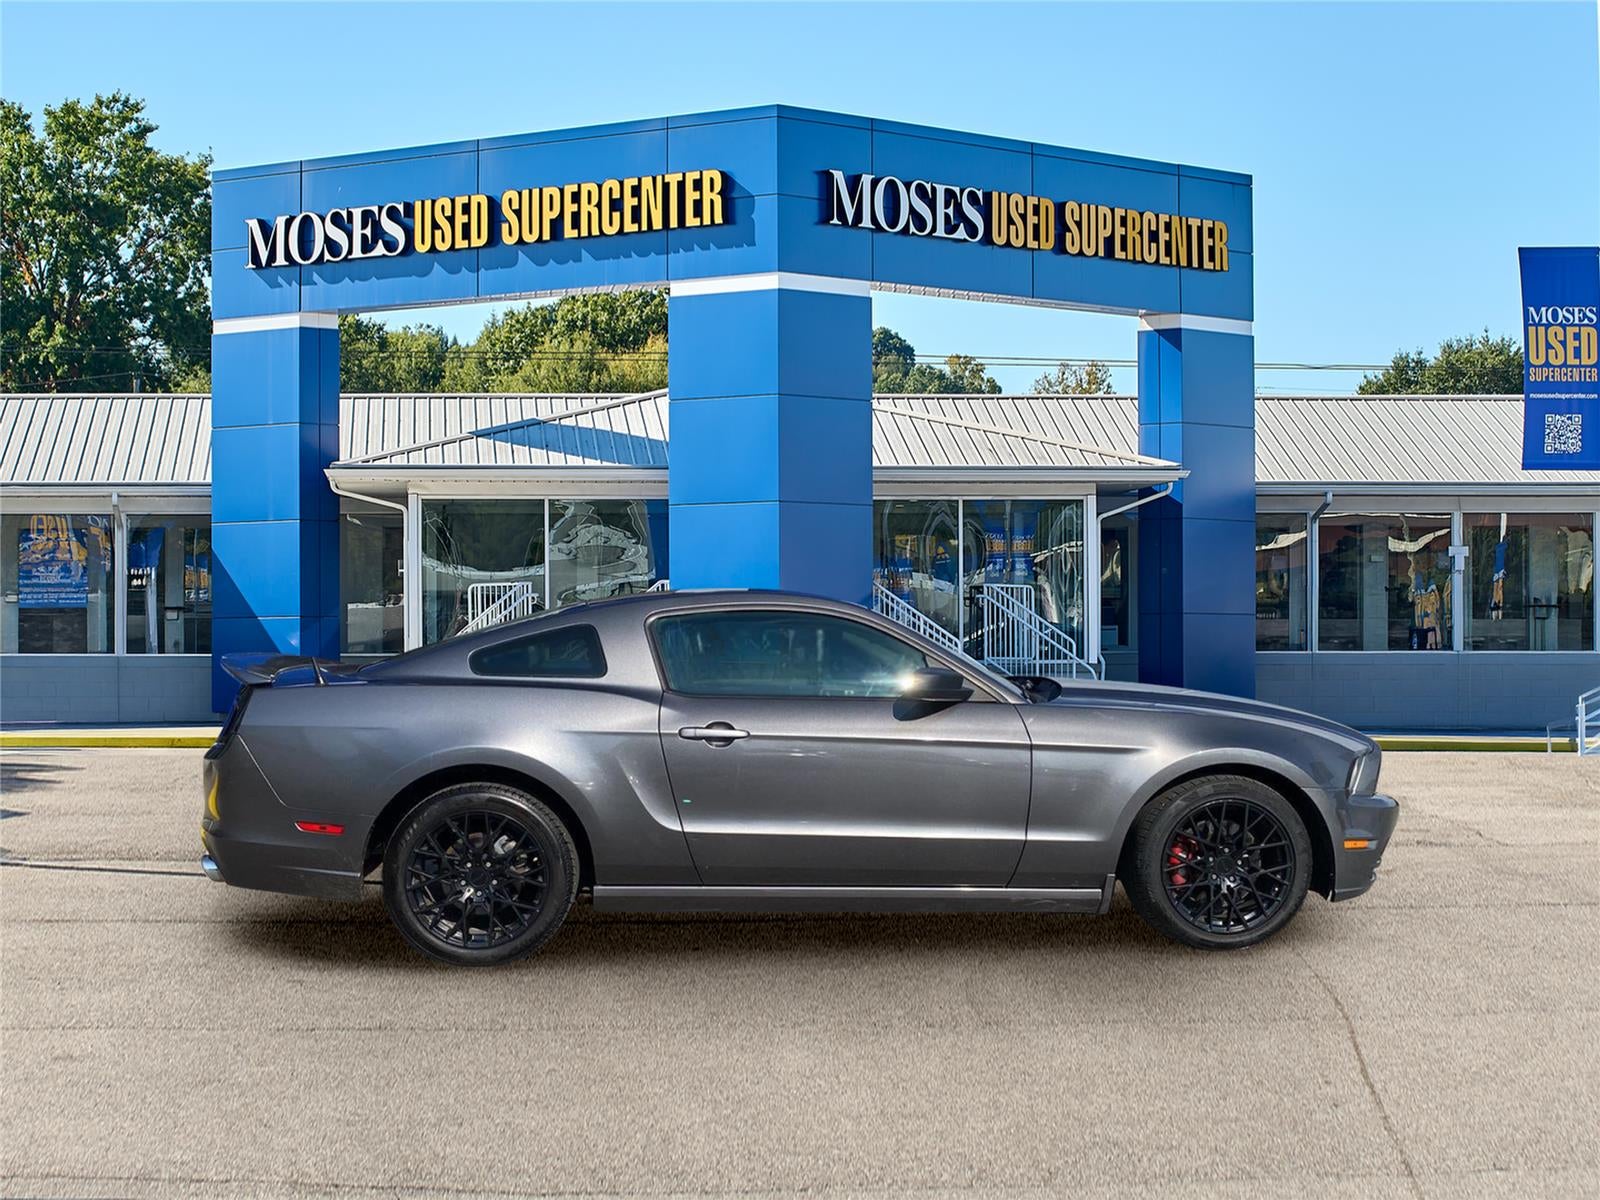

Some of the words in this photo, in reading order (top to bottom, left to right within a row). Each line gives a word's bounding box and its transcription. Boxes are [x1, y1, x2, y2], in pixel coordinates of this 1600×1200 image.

[244, 202, 407, 270] MOSES
[413, 193, 489, 254] USED
[500, 168, 724, 246] SUPERCENTER
[828, 168, 985, 243] MOSES
[991, 190, 1056, 251] USED
[1065, 200, 1230, 272] SUPERCENTER
[1528, 306, 1597, 324] MOSES
[1528, 326, 1598, 366] USED
[1529, 367, 1598, 382] SUPERCENTER
